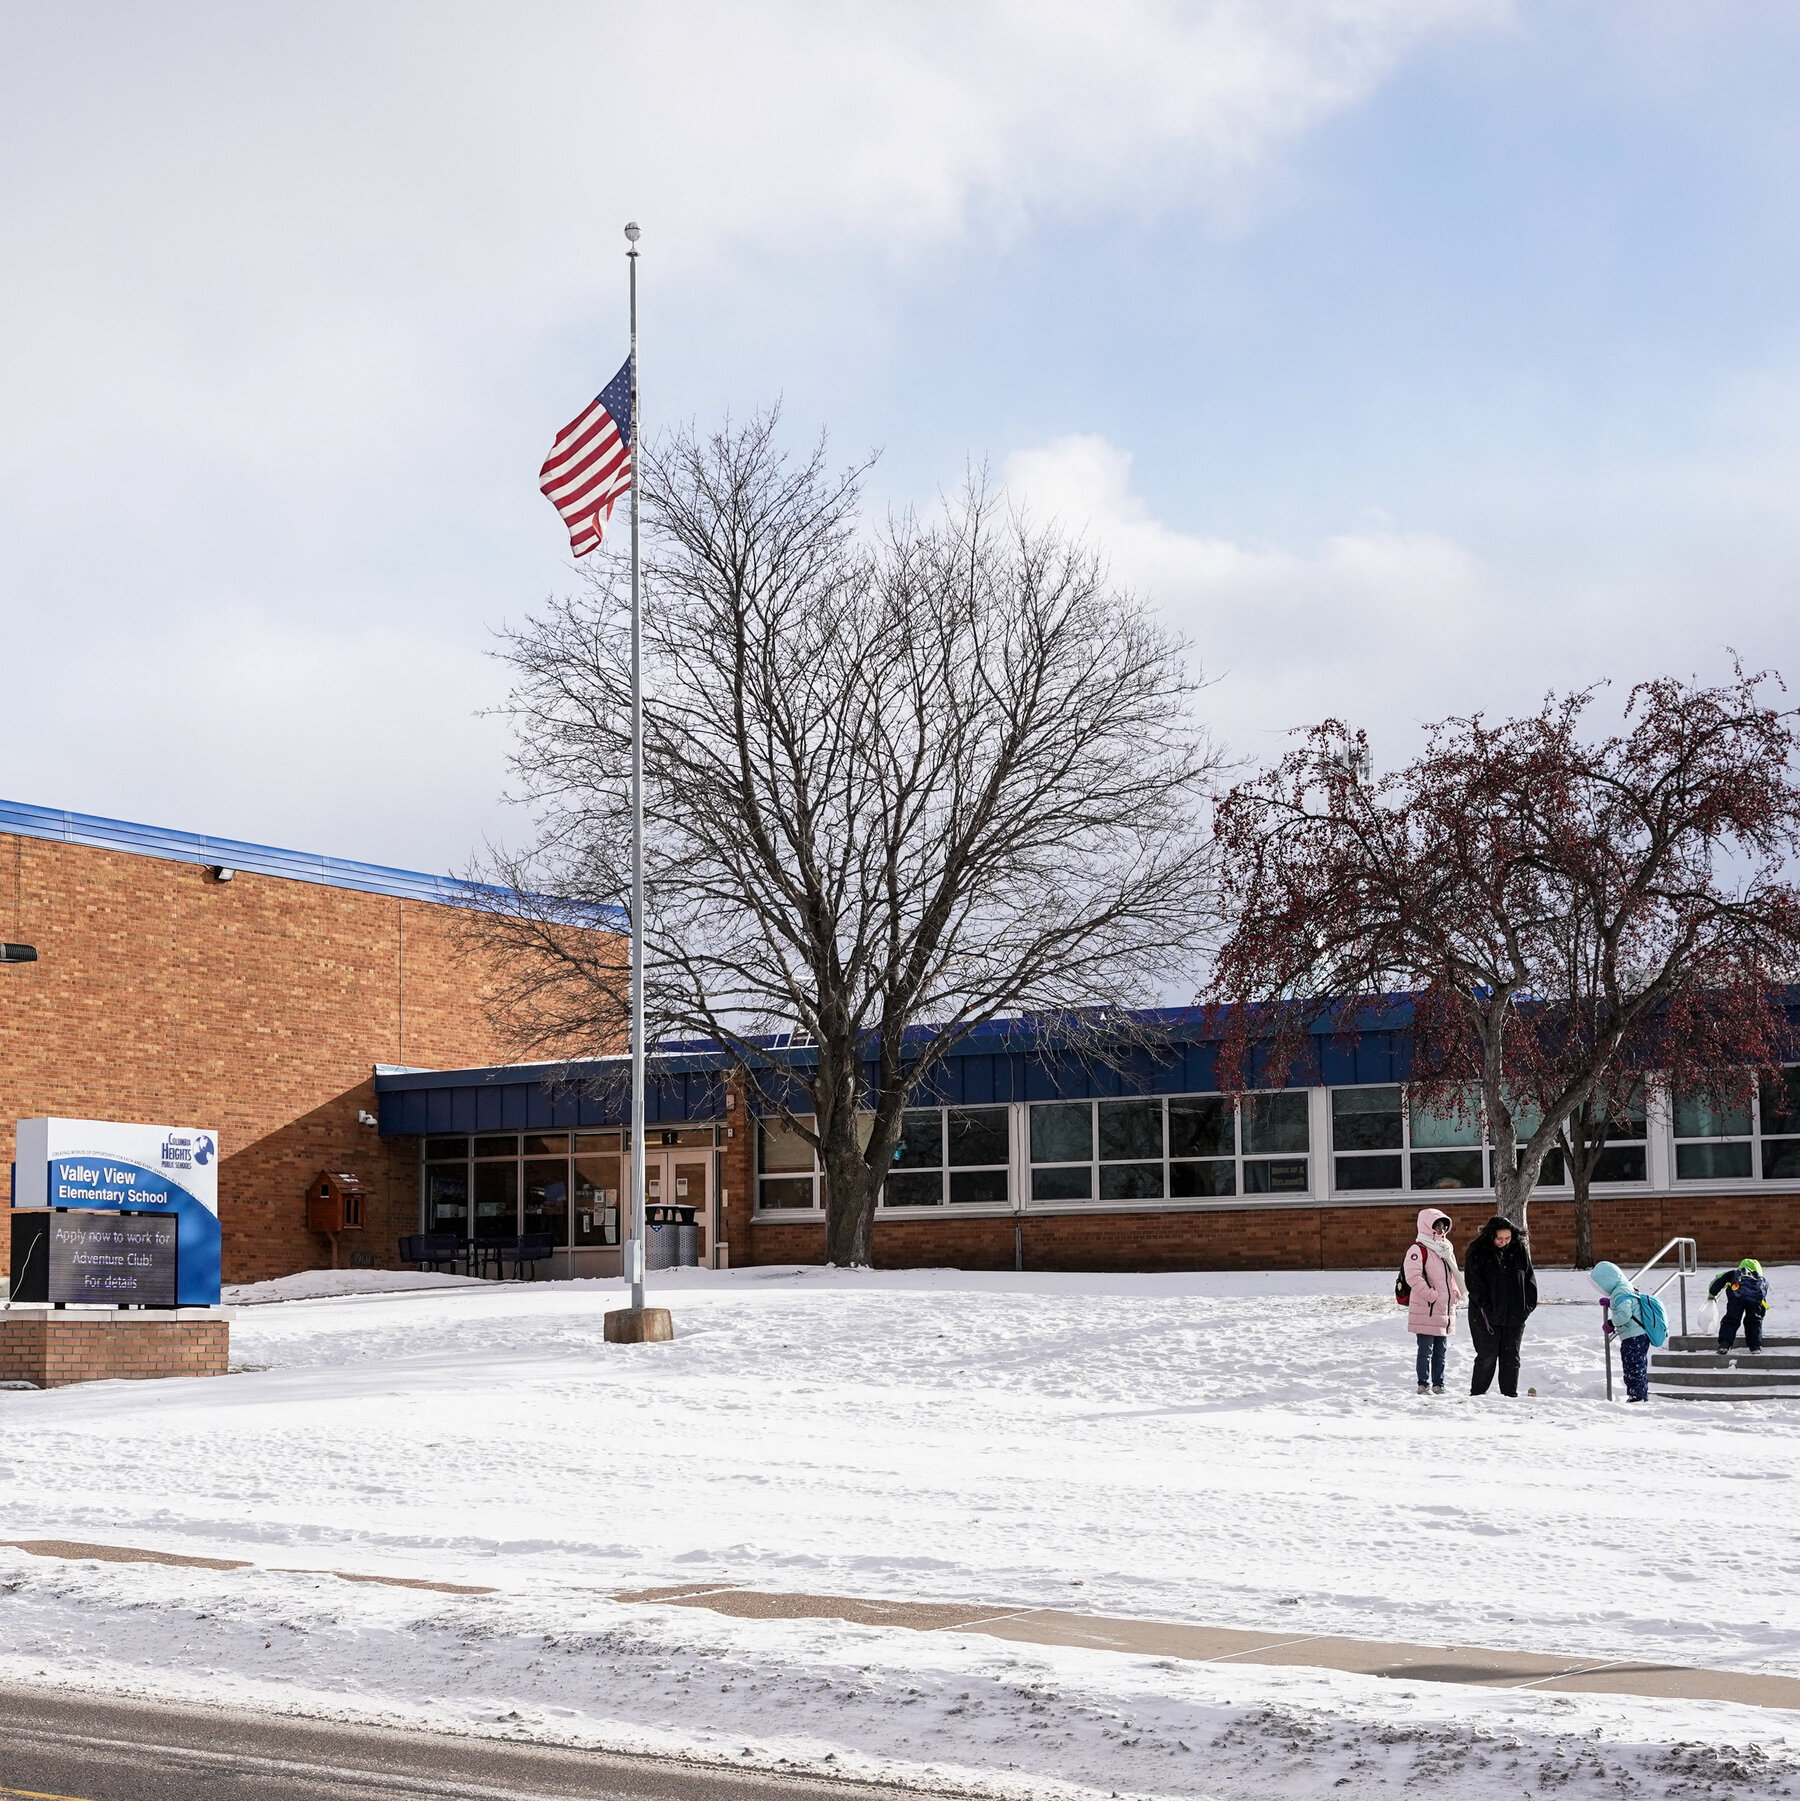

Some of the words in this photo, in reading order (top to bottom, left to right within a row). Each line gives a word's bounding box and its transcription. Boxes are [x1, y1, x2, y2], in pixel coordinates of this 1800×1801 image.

[168, 1133, 191, 1146] COLUMBIA
[667, 1133, 672, 1143] 1
[162, 1142, 192, 1161] HEIGHTS
[59, 1164, 100, 1186] Valley
[103, 1167, 136, 1184] View
[58, 1186, 124, 1204] Elementary
[128, 1189, 167, 1203] School
[56, 1228, 86, 1244] Apply
[89, 1232, 110, 1242] now
[113, 1232, 124, 1242] to
[126, 1232, 152, 1244] work
[155, 1231, 170, 1244] for
[72, 1252, 124, 1264] Adventure
[127, 1253, 152, 1266] Club!
[84, 1275, 101, 1288] For
[104, 1275, 137, 1288] details
